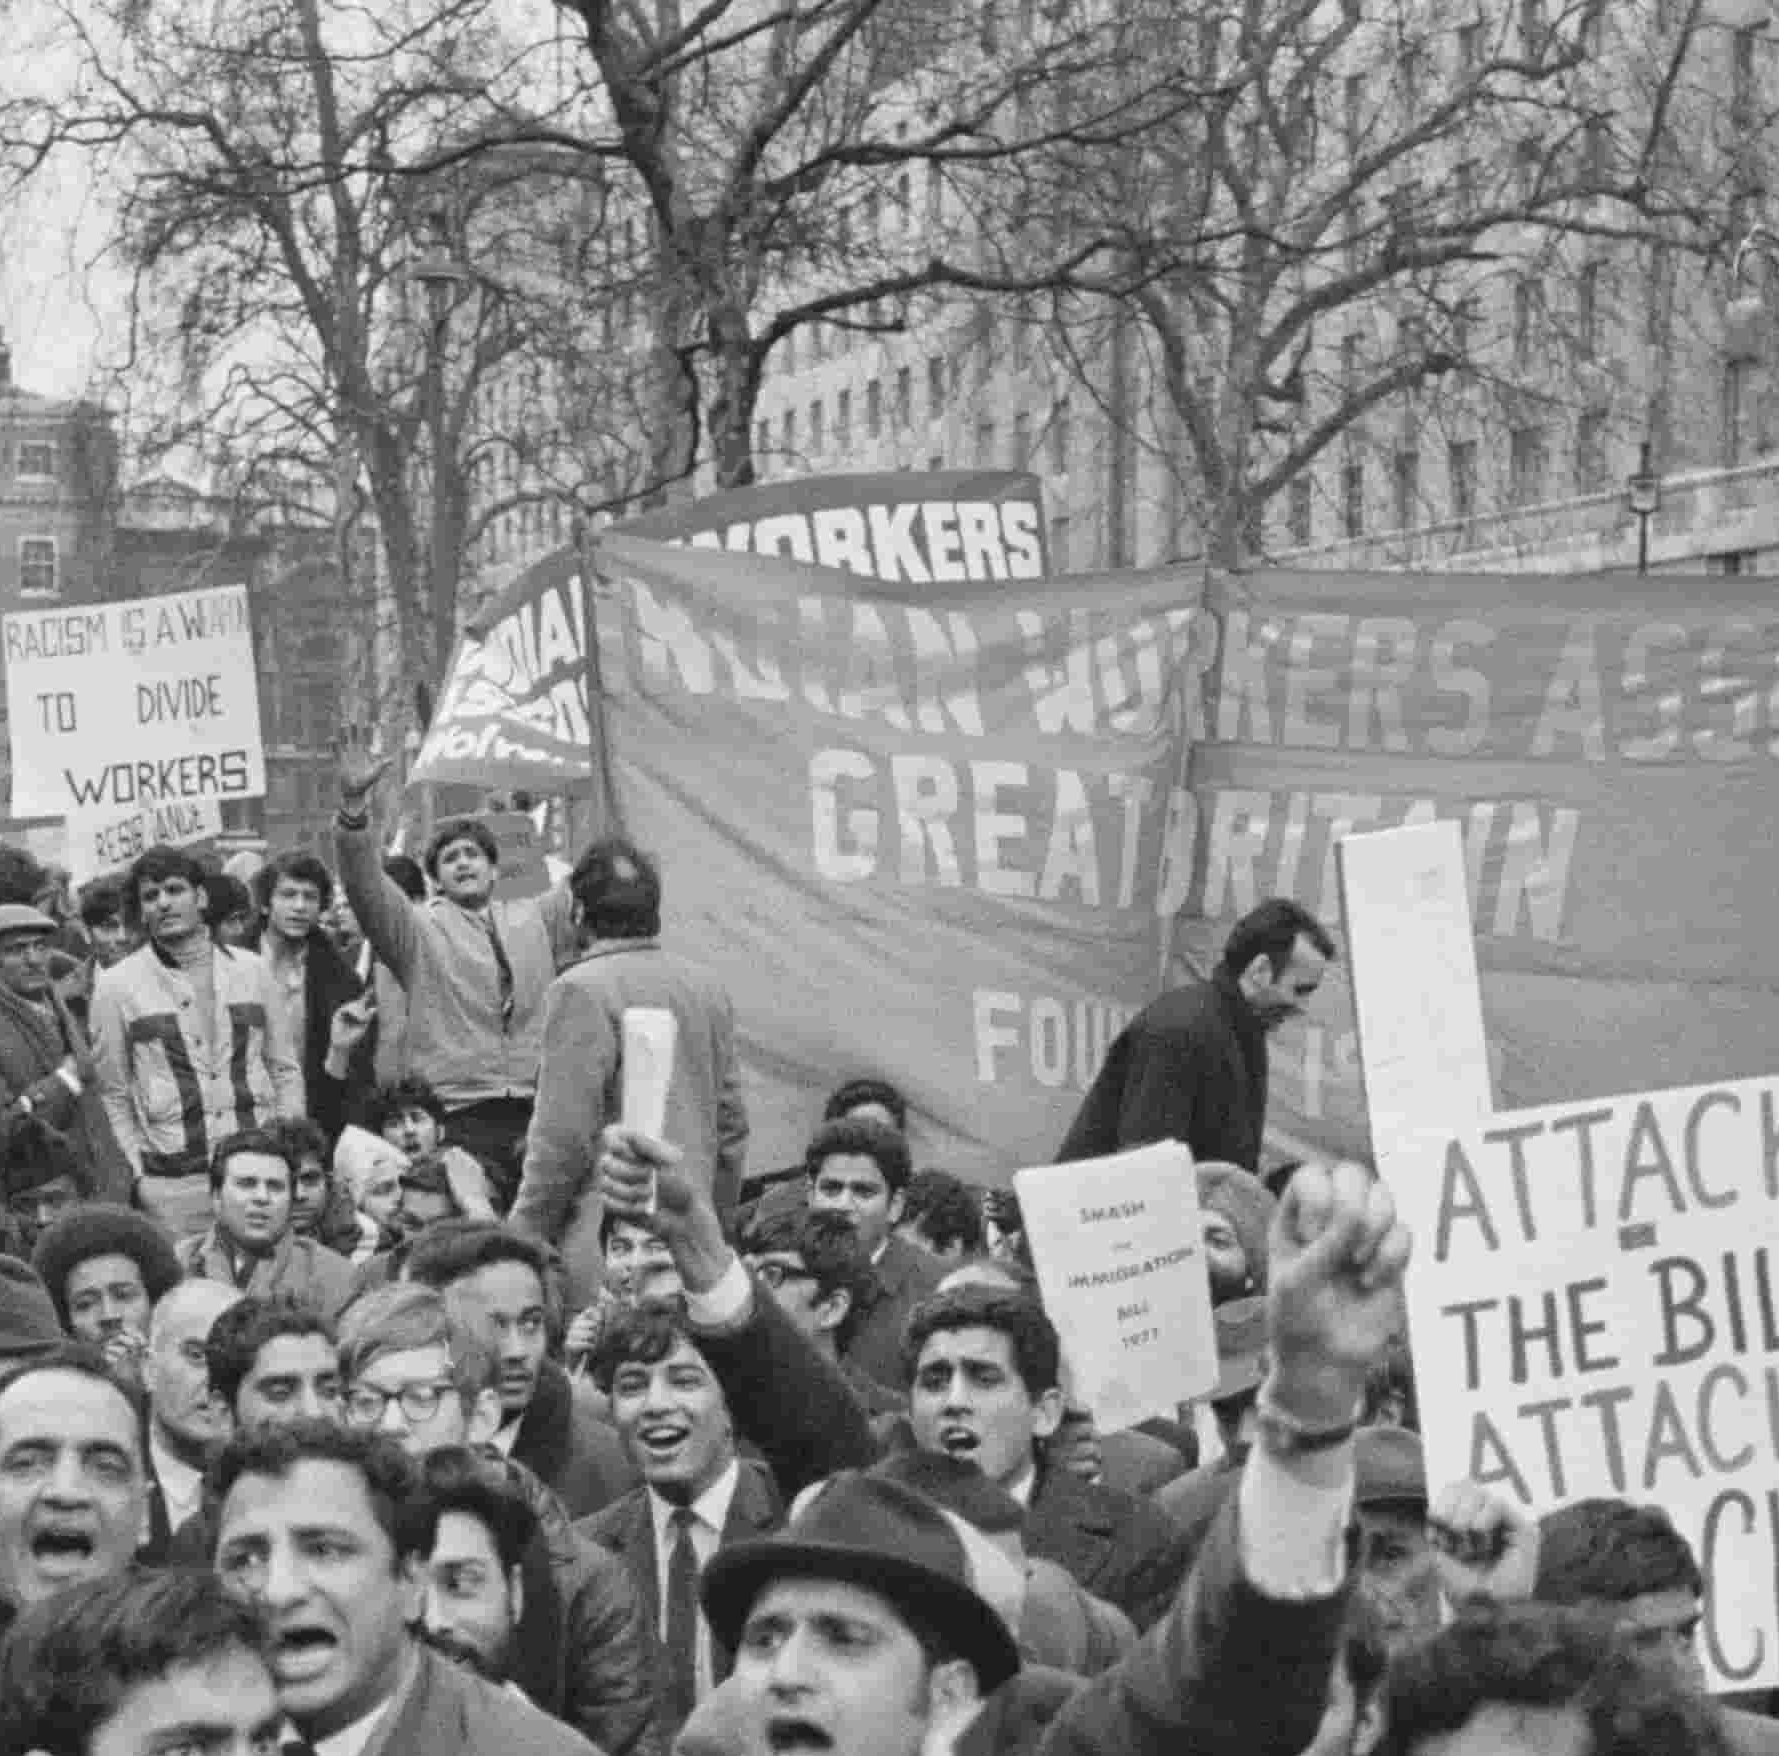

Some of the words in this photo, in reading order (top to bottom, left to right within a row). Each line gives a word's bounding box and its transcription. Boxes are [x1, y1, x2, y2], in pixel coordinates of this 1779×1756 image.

[5, 611, 110, 661] RACISM
[122, 607, 147, 651] IS
[156, 606, 178, 646] A
[37, 692, 77, 733] TO
[137, 674, 224, 724] DIVIDE
[63, 750, 248, 805] WORKERS
[807, 747, 1155, 909] GREAT
[1157, 786, 1581, 944] BRITIN
[1079, 1199, 1146, 1224] SMASH
[1069, 1247, 1197, 1289] IMMIGRATION
[1441, 1278, 1619, 1390] THE
